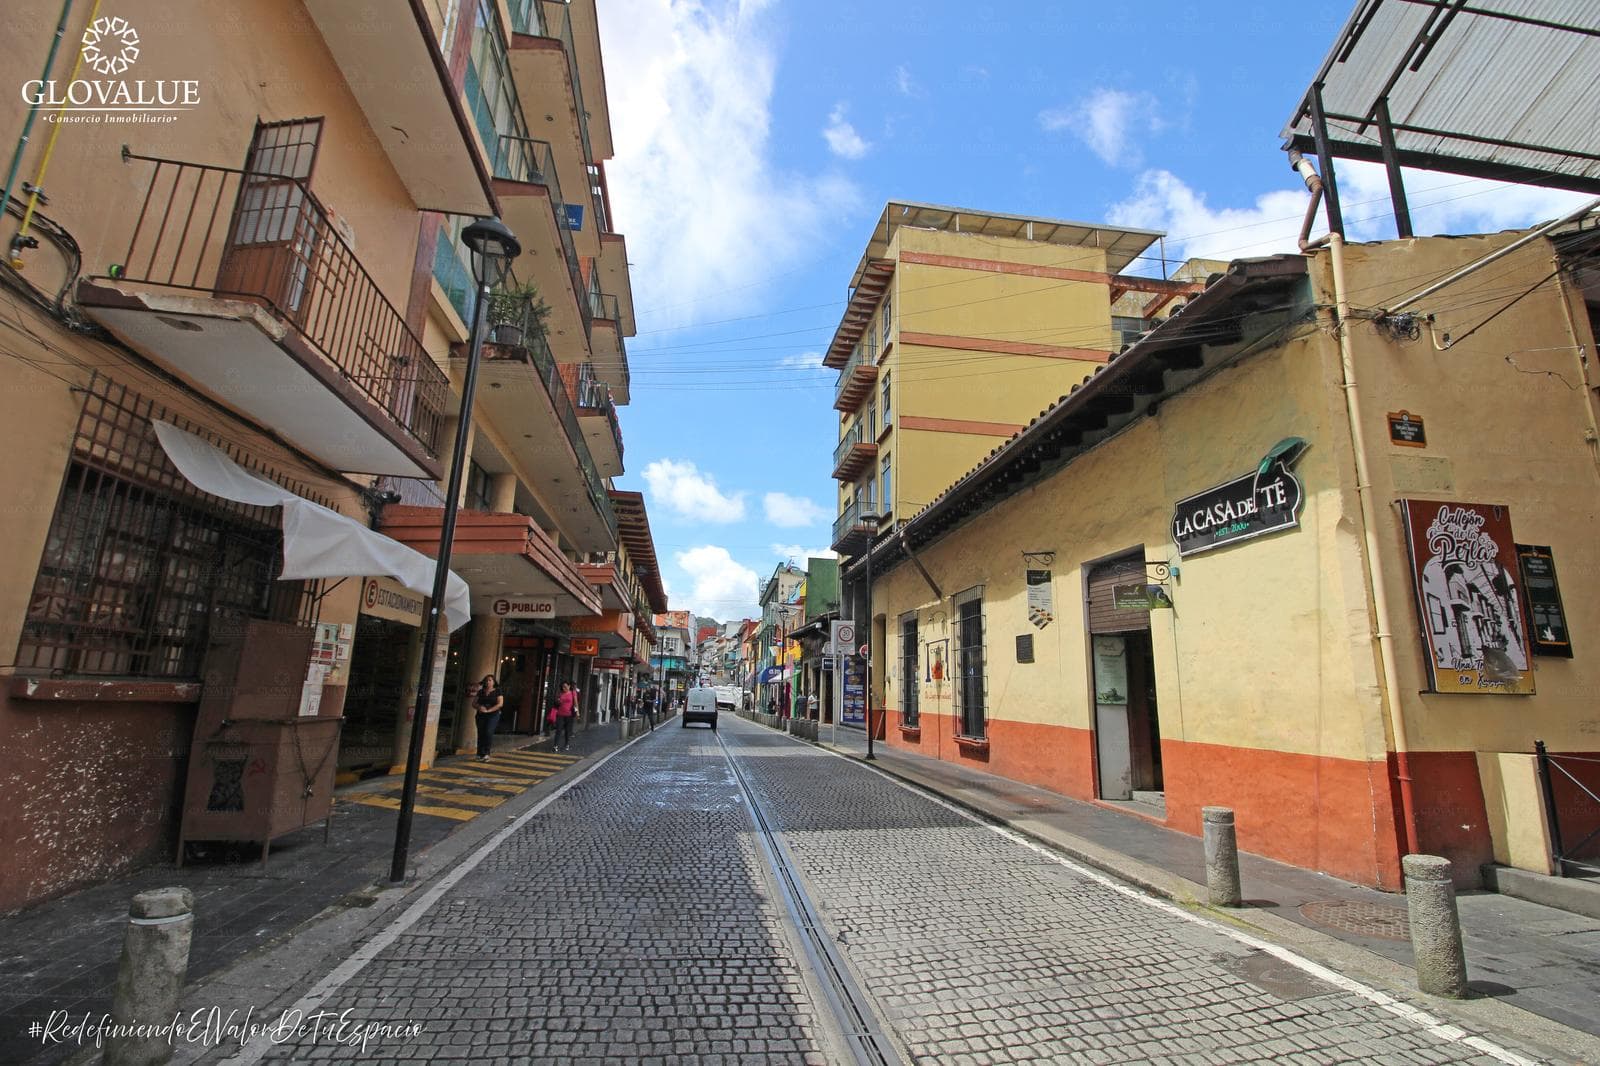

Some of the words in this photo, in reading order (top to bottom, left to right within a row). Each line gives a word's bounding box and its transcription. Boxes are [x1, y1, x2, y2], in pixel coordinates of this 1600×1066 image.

[1175, 516, 1194, 537] LA
[1192, 499, 1238, 531] CASA
[1260, 477, 1287, 508] TÉ
[1438, 506, 1485, 530] Callejón
[1454, 528, 1465, 539] de
[1468, 529, 1477, 539] la
[1430, 533, 1493, 569] Perla
[377, 588, 423, 617] ESTACIONAMIENTO
[1451, 658, 1474, 672] Una
[1459, 674, 1473, 685] en
